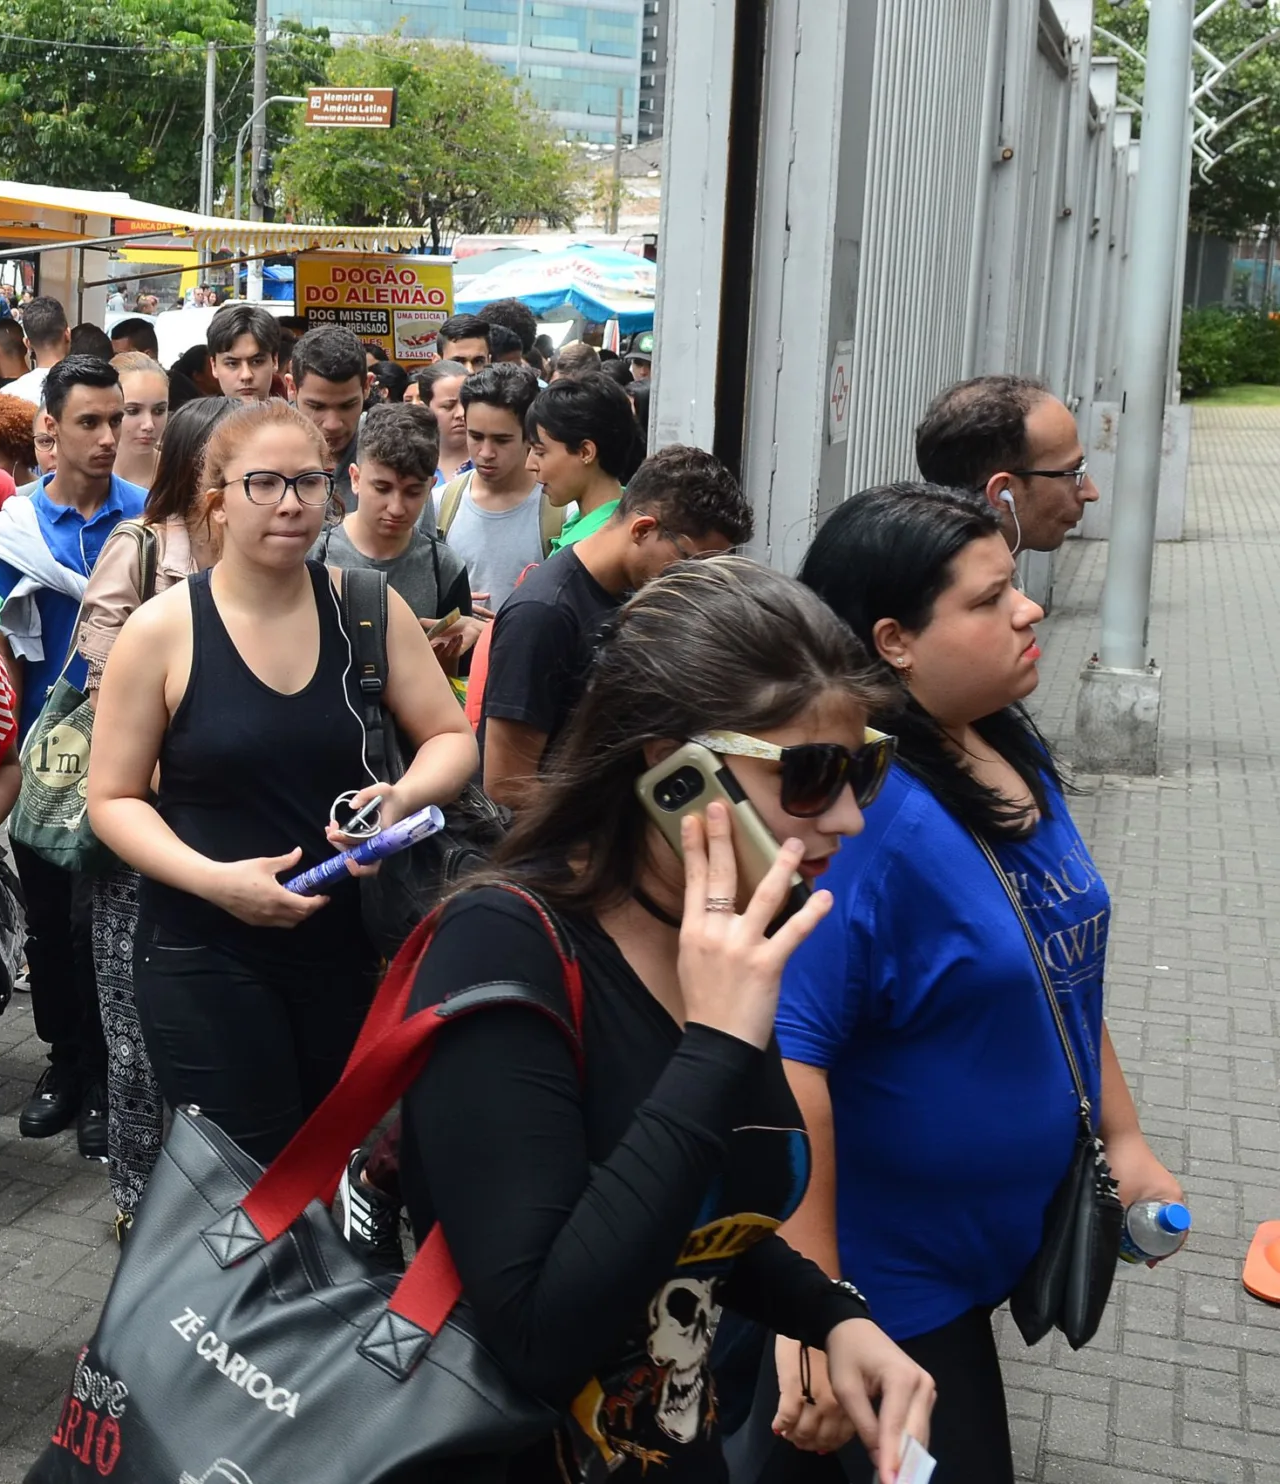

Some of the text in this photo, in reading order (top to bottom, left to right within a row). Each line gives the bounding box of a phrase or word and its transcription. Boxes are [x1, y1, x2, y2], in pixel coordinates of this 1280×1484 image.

[323, 92, 374, 102] Memorial da
[323, 103, 388, 114] América Latina
[130, 221, 156, 231] BANCA
[157, 222, 172, 231] DAS
[331, 265, 417, 287] DOGÃO
[305, 285, 446, 306] DO ALEMÃO
[308, 310, 387, 322] DOG MISTER
[396, 312, 413, 320] UMA
[170, 1307, 301, 1419] ZÉ CARIOCA
